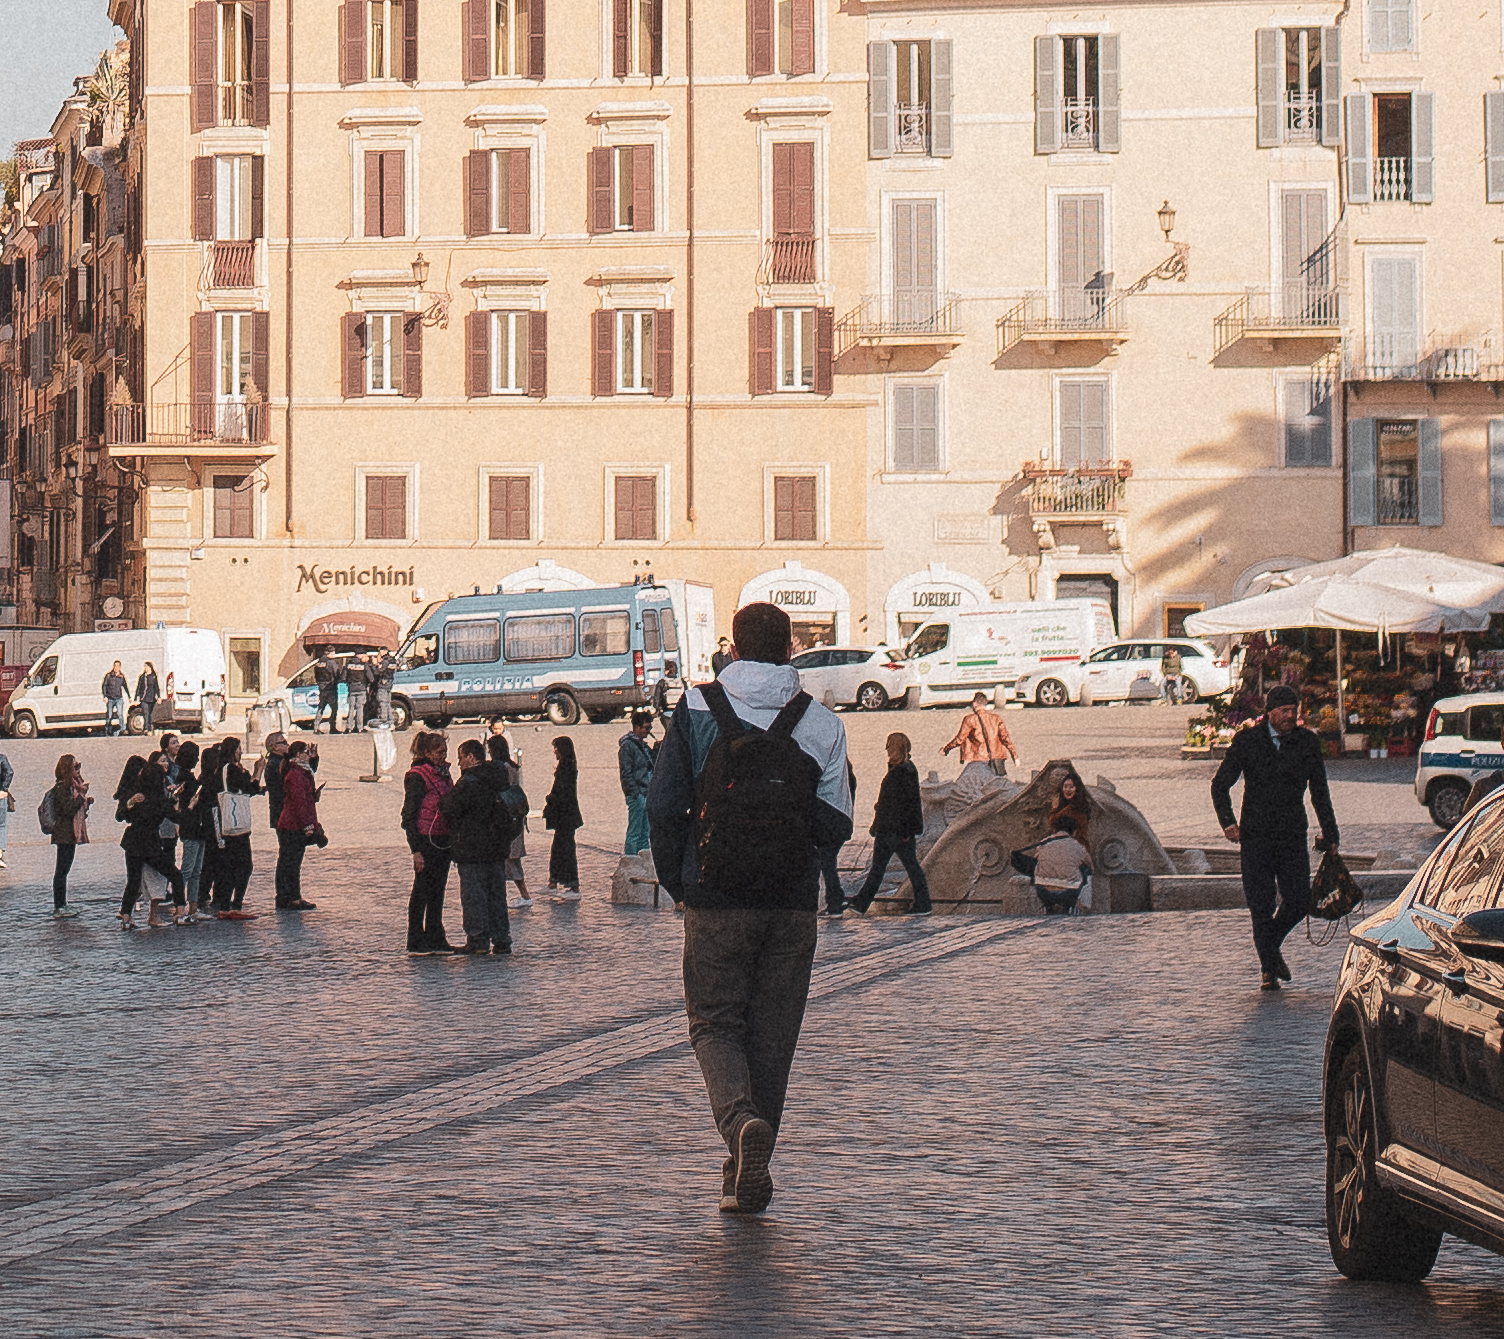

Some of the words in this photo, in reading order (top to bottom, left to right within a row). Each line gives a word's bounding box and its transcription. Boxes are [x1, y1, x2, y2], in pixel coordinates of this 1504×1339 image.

[295, 563, 415, 594] Menichini
[768, 589, 817, 606] LORIBLU
[912, 591, 962, 607] LORIBLU
[321, 621, 366, 635] Menichini
[461, 676, 534, 692] POLIZIA
